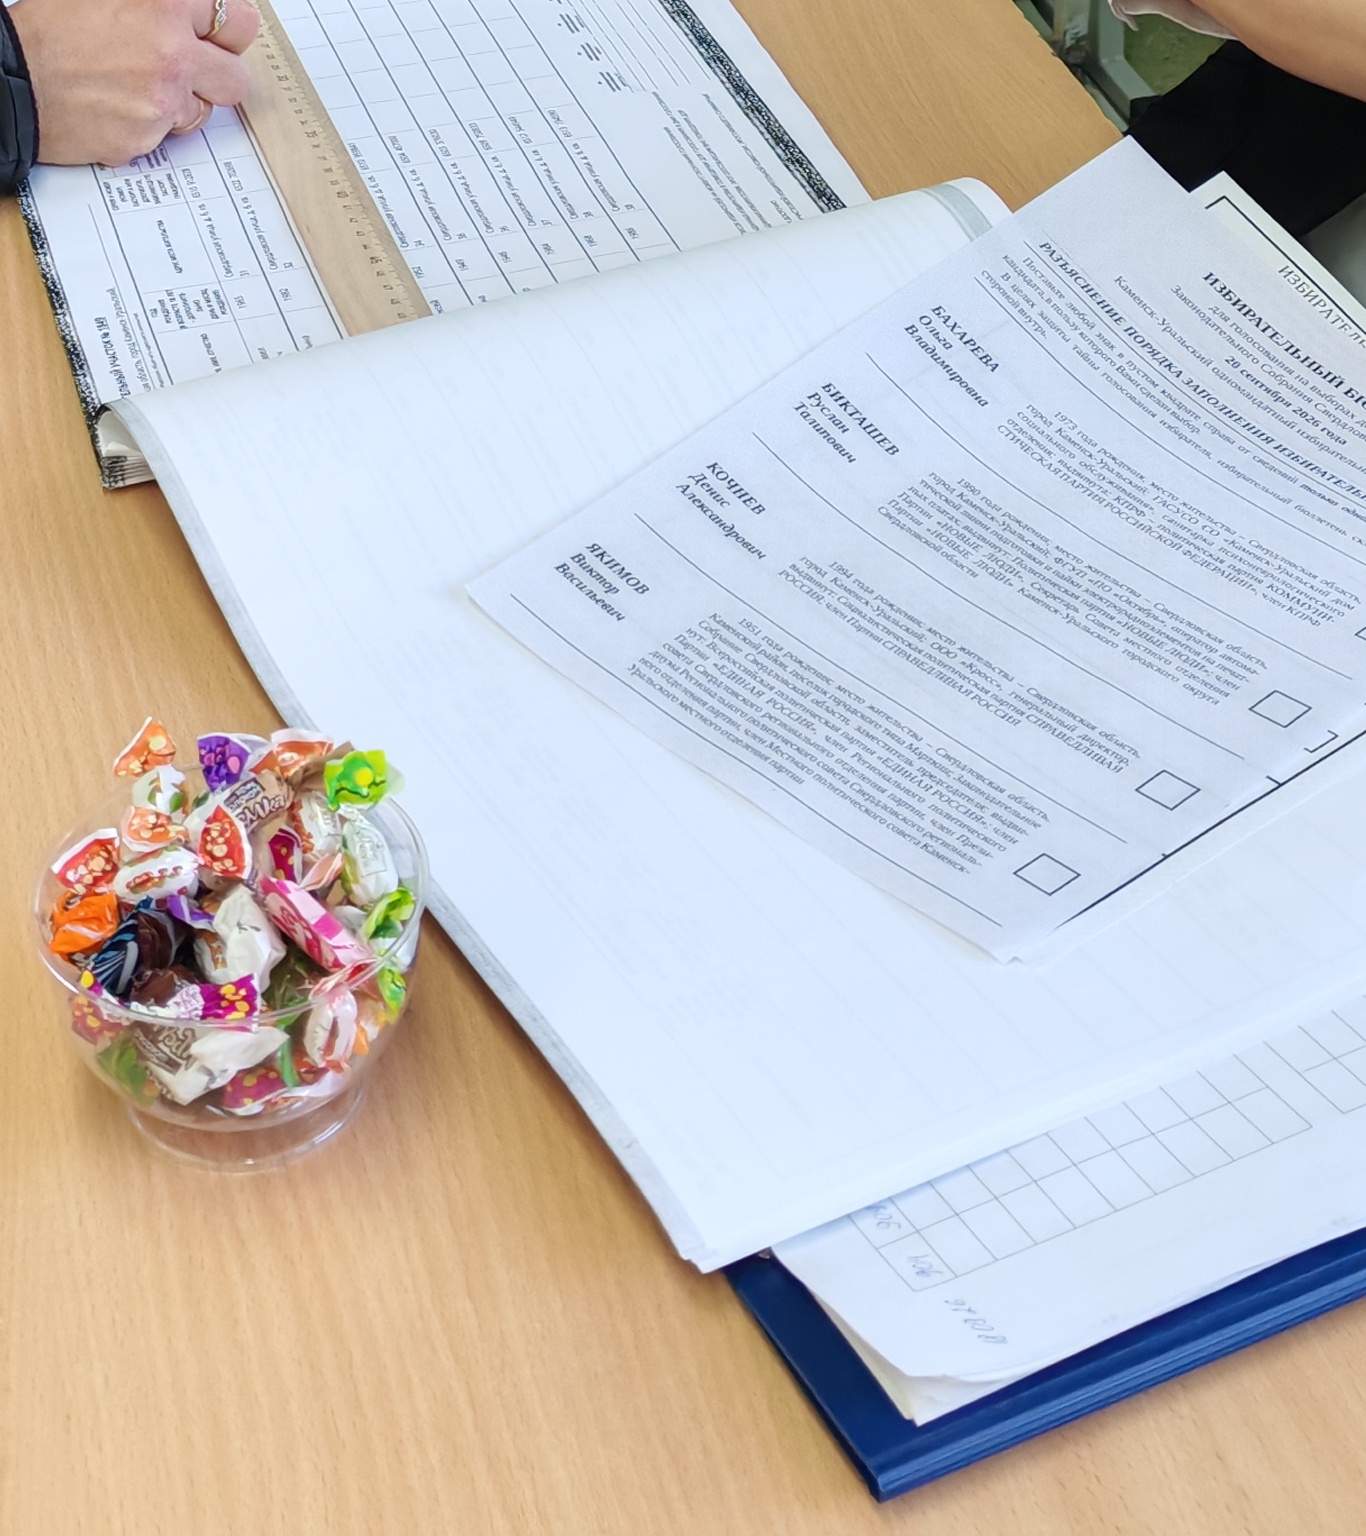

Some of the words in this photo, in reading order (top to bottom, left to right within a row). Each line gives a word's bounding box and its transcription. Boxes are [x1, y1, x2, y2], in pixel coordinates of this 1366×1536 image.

[918, 314, 953, 350] Ольга
[930, 305, 999, 373] БАХАРЕВА
[1038, 242, 1126, 326] РАЗЪЯСНЕНИЕ
[1122, 325, 1183, 379] ПОРЯДКА
[1181, 377, 1276, 445] ЗАПОЛНЕНИЯ
[1113, 275, 1214, 367] Каменск-Уральский
[1211, 366, 1299, 430] одномандатный
[1170, 284, 1260, 365] Законодательного
[1259, 363, 1315, 404] Собрания
[1202, 271, 1345, 389] ИЗБИРАТЕЛЬНЫЙ
[1207, 305, 1231, 323] для
[1228, 321, 1295, 376] голосования
[1293, 374, 1310, 386] на
[1309, 384, 1357, 420] выборах
[903, 323, 989, 407] Владимировна
[793, 401, 856, 463] Талипович
[806, 391, 850, 434] Руслан
[820, 382, 899, 455] БИКТАШЕВ
[1053, 411, 1078, 431] 1973
[1224, 355, 1242, 369] 20
[1239, 368, 1293, 408] сентября
[1291, 405, 1322, 427] 2026
[1319, 426, 1347, 445] года
[687, 472, 731, 508] Денис
[705, 461, 766, 515] КОЧНЕВ
[956, 478, 981, 496] 1990
[675, 484, 766, 560] Александрович
[553, 561, 625, 621] Васильевич
[569, 552, 620, 594] Виктор
[585, 543, 650, 595] ЯКИМОВ
